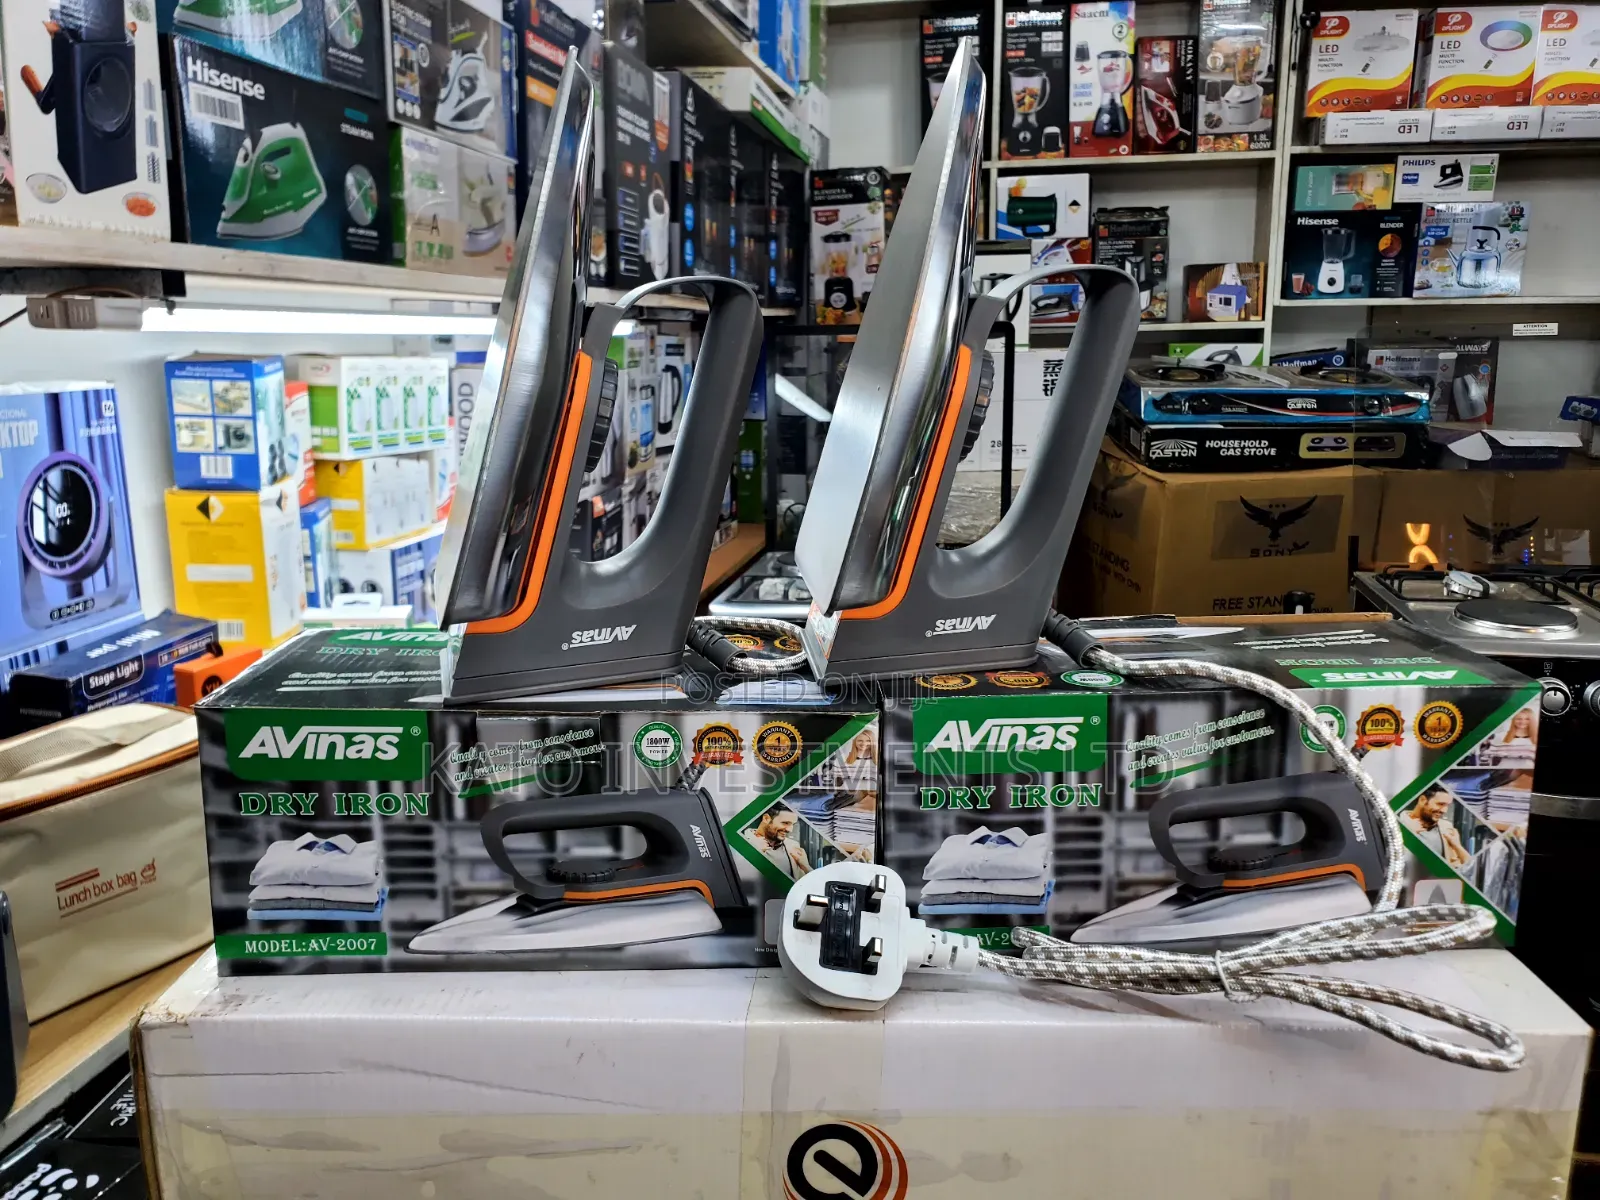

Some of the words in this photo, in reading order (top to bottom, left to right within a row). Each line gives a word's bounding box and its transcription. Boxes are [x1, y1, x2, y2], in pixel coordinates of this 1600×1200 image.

[1440, 40, 1462, 50] LED
[1546, 38, 1567, 48] LED
[1319, 44, 1340, 54] LED
[187, 55, 266, 101] Hisense
[1398, 124, 1418, 134] LED
[1506, 122, 1528, 131] LED
[1250, 142, 1272, 150] 600W
[1402, 158, 1436, 166] PHILIPS
[1296, 217, 1340, 226] Hisense
[1455, 344, 1488, 352] ALWAYS
[1206, 440, 1268, 448] HOUSEHOLD
[1243, 448, 1277, 456] STOVE
[1213, 598, 1244, 611] FREE
[316, 646, 389, 656] DRY
[89, 670, 116, 690] Stage
[116, 660, 140, 680] Light
[1423, 706, 1454, 718] WARRANTY
[1370, 718, 1394, 728] 100%
[762, 727, 795, 738] WARRANTY
[1125, 735, 1163, 753] Quality
[1163, 729, 1191, 744] comes
[1192, 721, 1216, 738] from
[1216, 708, 1266, 730] conscience
[488, 745, 518, 758] comes
[518, 739, 544, 754] from
[544, 728, 595, 748] conscience
[646, 737, 671, 746] 1800W
[706, 736, 732, 746] 100%
[1422, 732, 1453, 744] WARRANTY
[762, 752, 794, 764] WARRANTY
[1128, 759, 1146, 772] and
[1148, 751, 1179, 767] creates
[1181, 742, 1208, 758] value
[1208, 737, 1226, 754] for
[920, 786, 995, 810] DRY
[1009, 784, 1102, 808] IRON
[239, 792, 319, 816] DRY
[334, 792, 429, 816] IRON
[57, 886, 92, 911] Lunch
[92, 880, 114, 898] box
[116, 871, 138, 889] bag
[244, 938, 378, 954] MODEL:AV-2007
